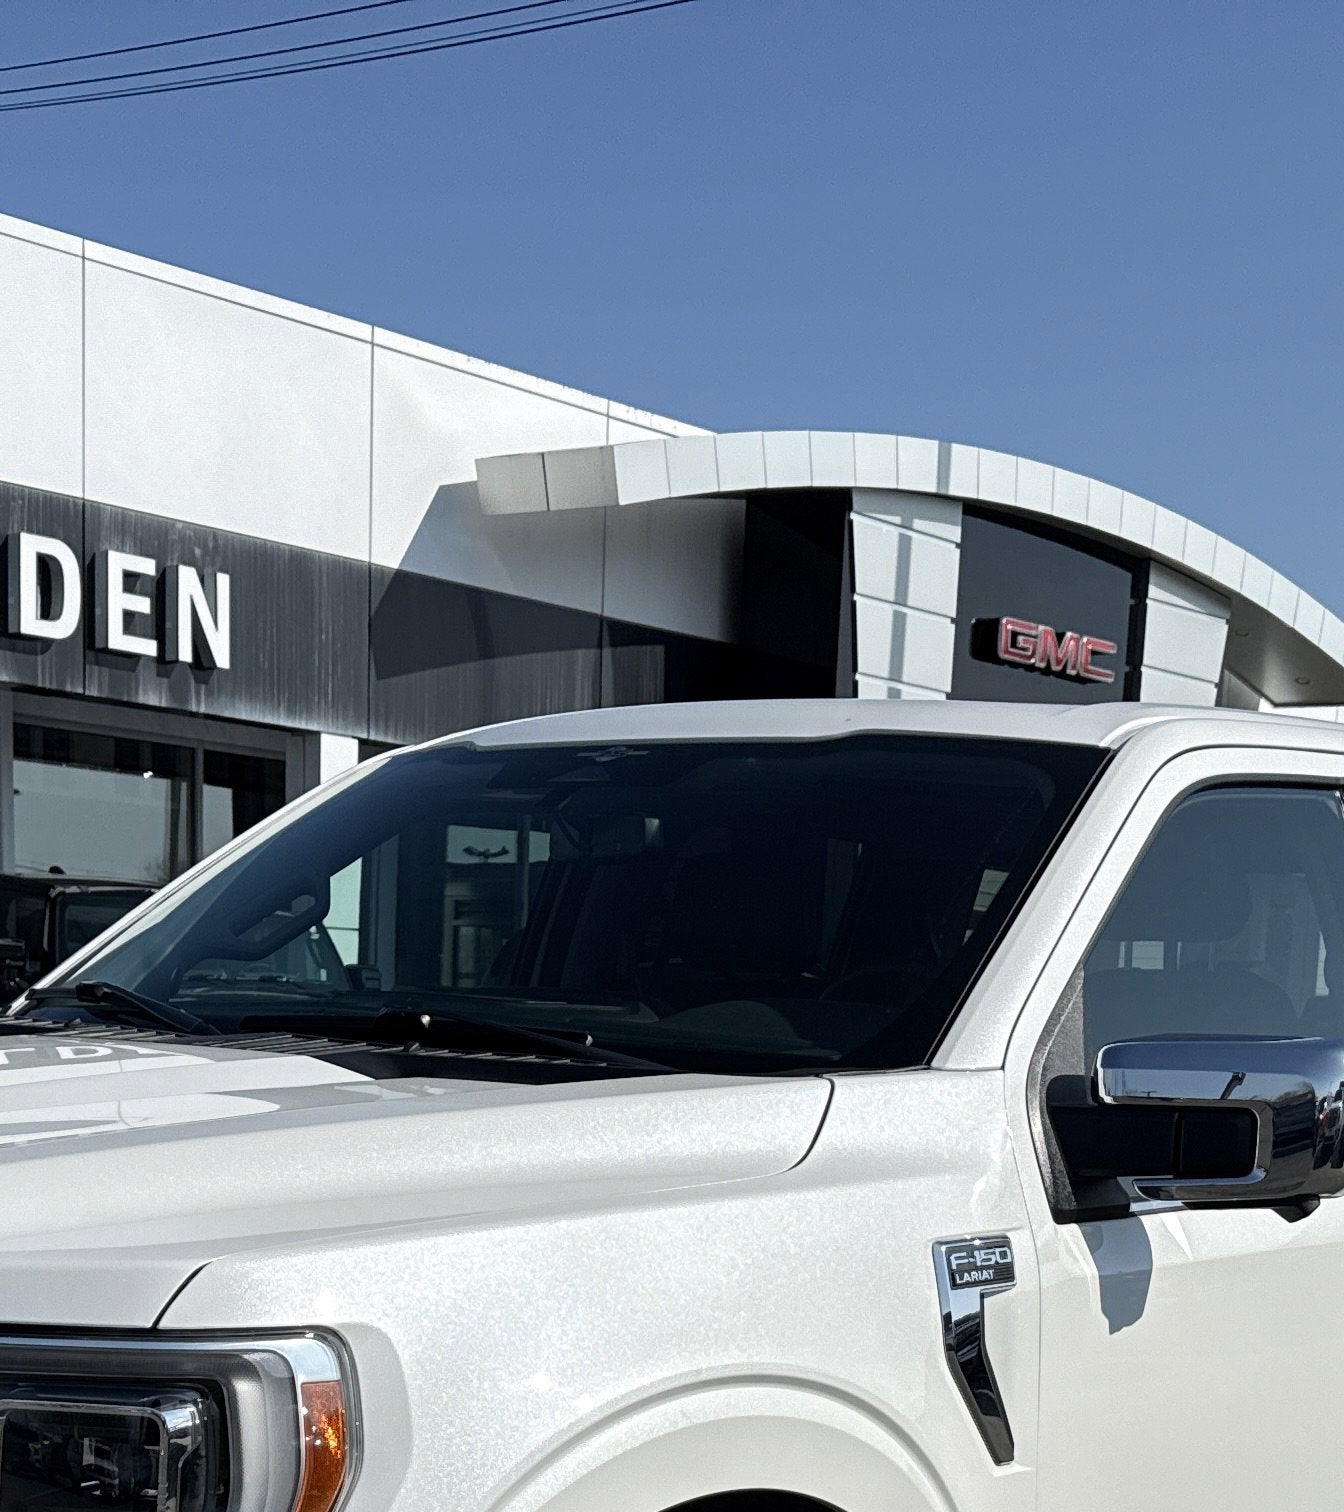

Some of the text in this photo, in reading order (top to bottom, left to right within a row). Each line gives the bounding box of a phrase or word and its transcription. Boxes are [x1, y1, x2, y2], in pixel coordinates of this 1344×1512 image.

[998, 617, 1117, 683] GMC
[950, 1247, 1012, 1270] F-150
[956, 1269, 994, 1284] LARIAT
